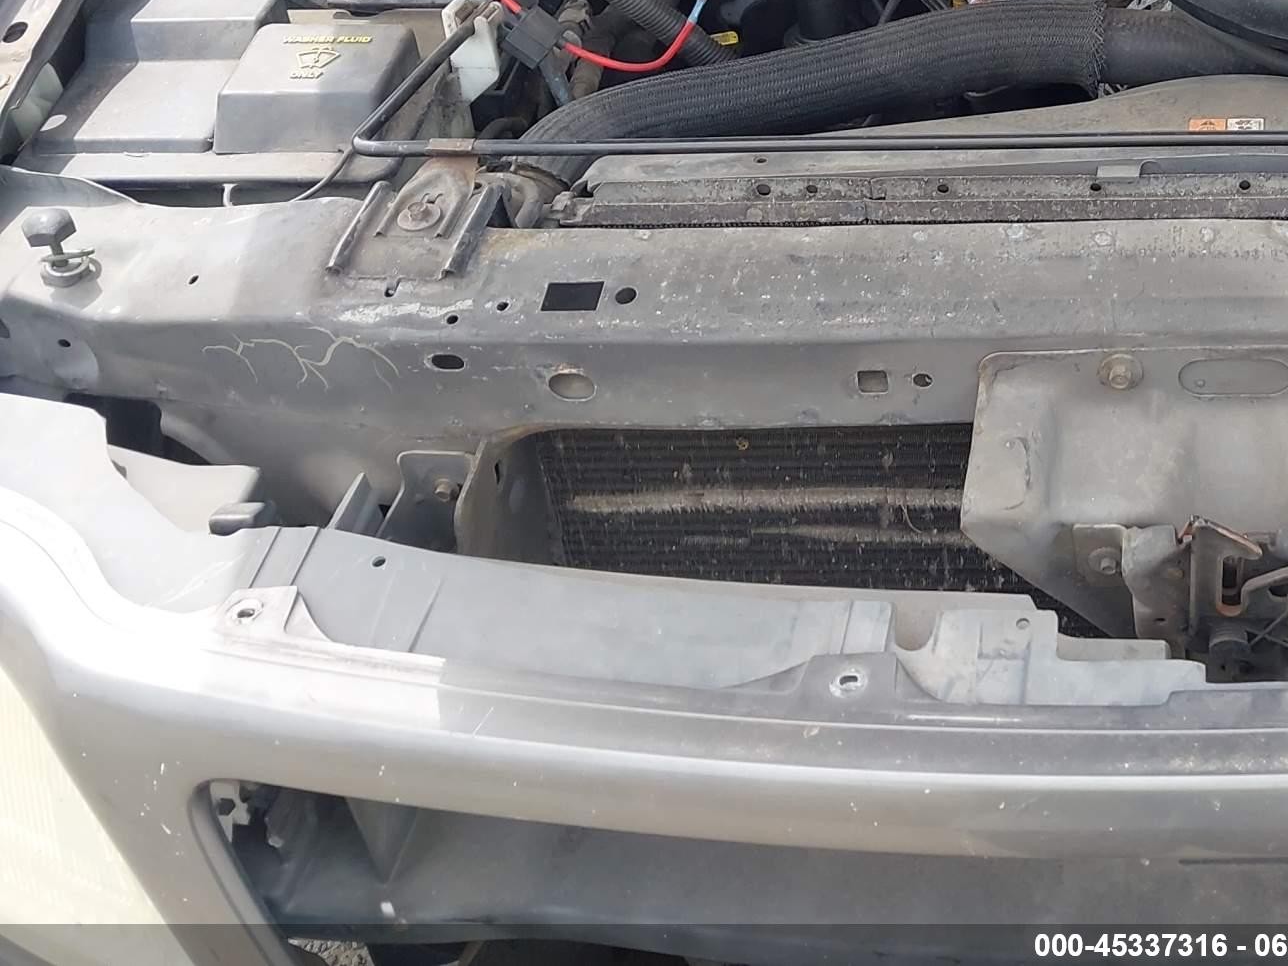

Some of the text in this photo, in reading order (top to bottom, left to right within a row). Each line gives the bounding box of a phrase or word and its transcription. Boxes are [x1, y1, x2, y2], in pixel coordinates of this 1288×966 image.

[283, 35, 372, 45] WASHER FLUID
[289, 70, 324, 80] ONLY
